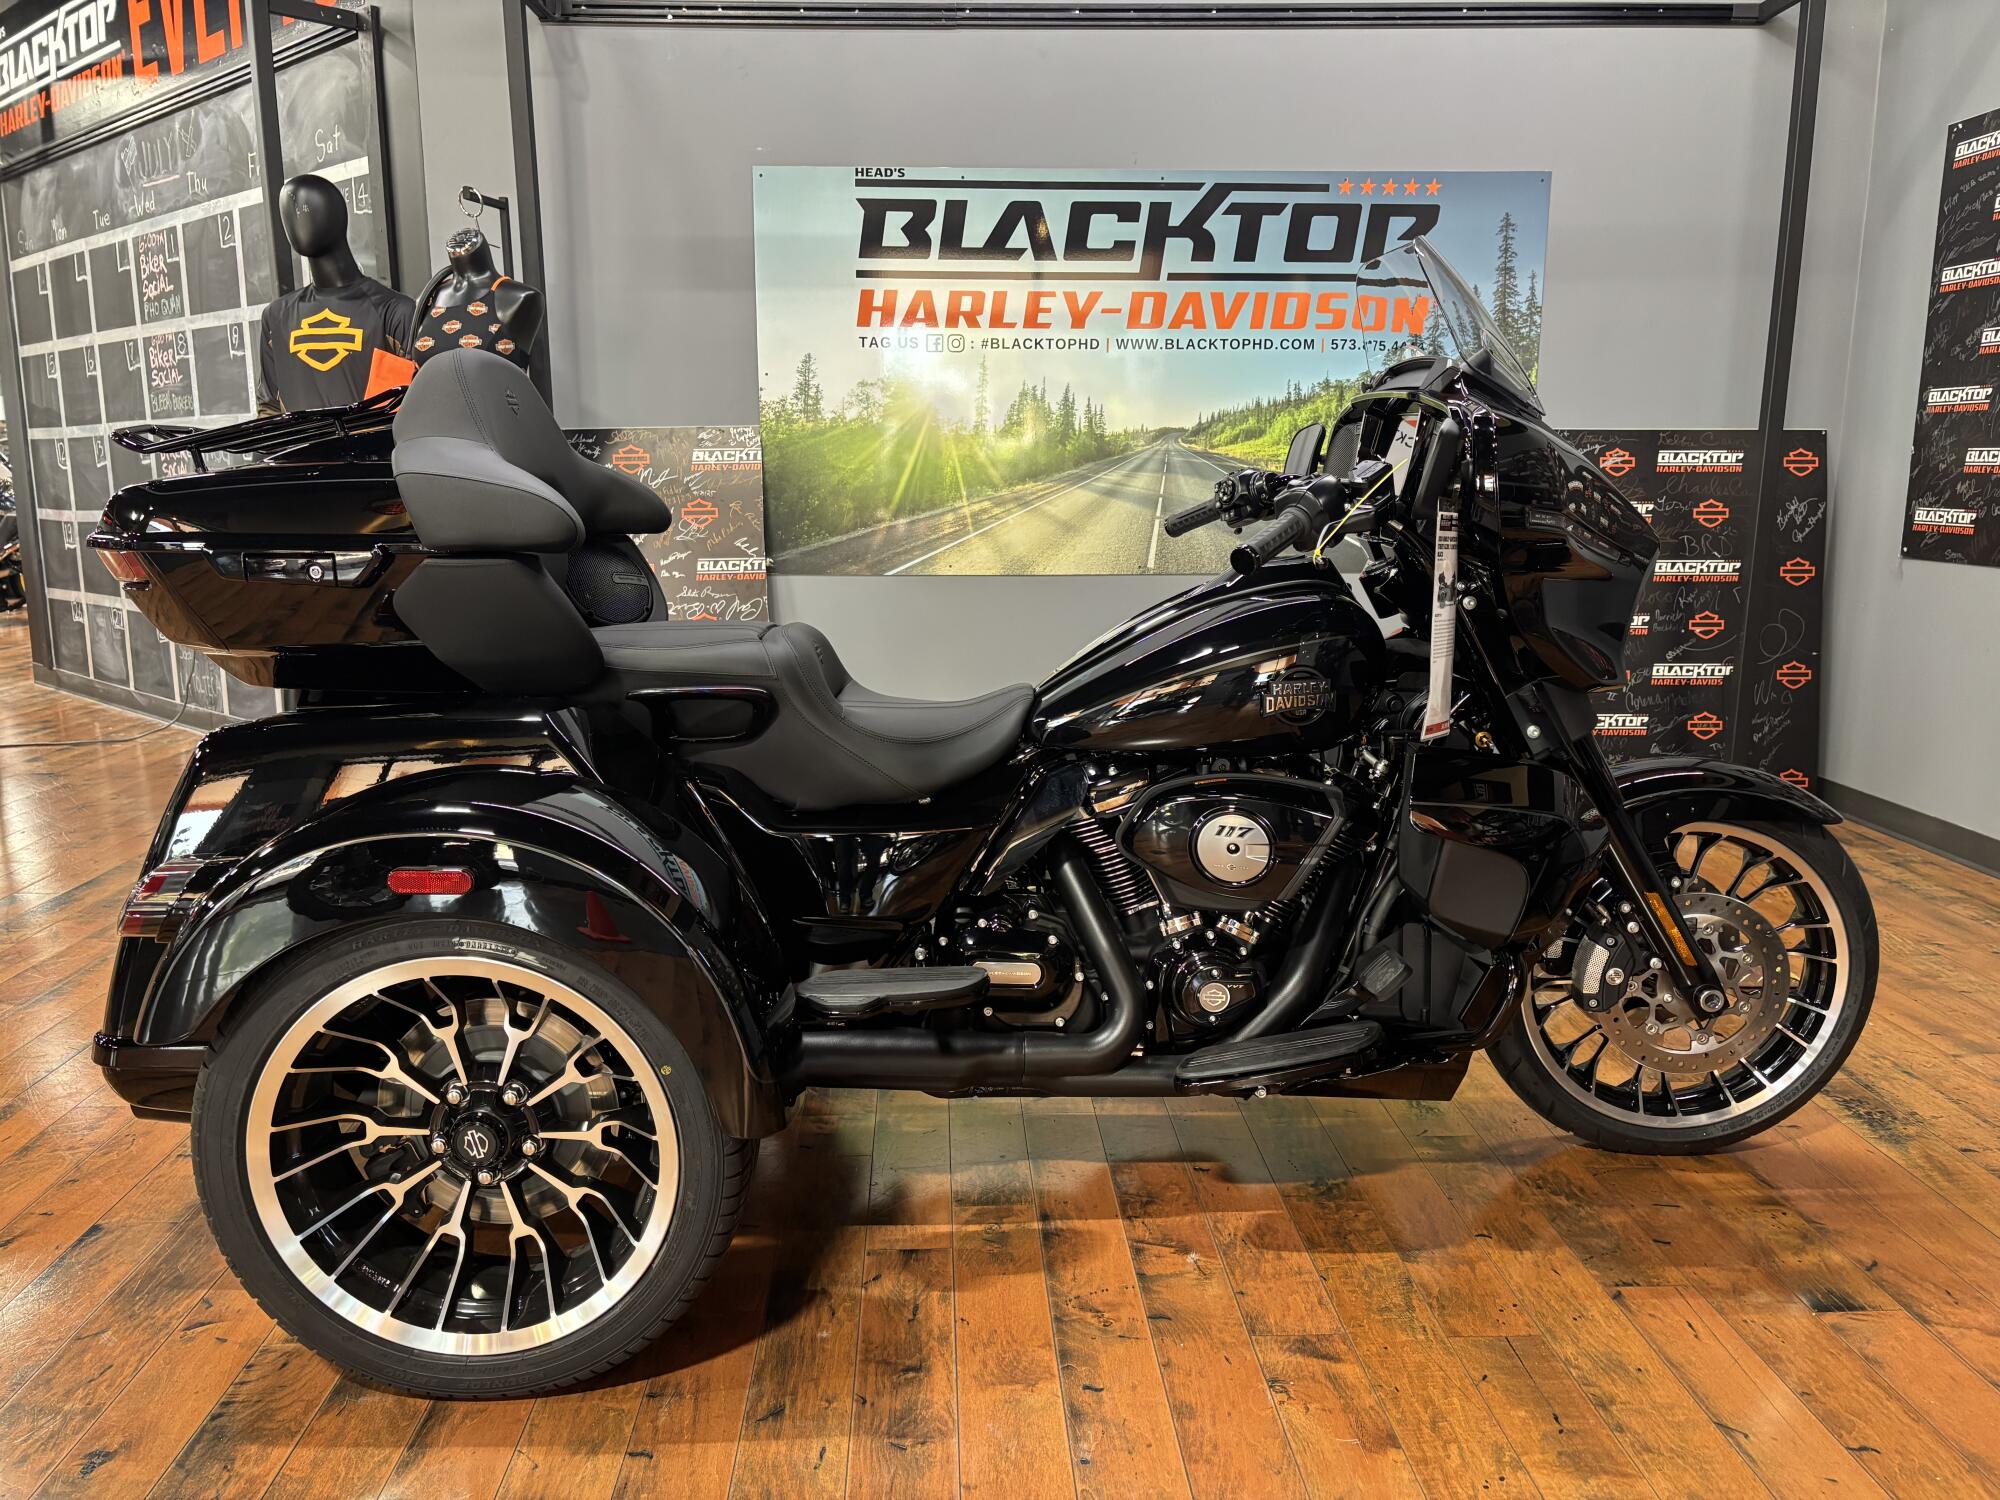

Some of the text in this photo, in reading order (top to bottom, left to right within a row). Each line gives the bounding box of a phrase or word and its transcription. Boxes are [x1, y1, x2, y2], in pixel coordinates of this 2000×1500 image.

[93, 209, 111, 230] Tue
[133, 190, 155, 217] Wed
[186, 171, 209, 196] Thu
[315, 124, 340, 162] Sat
[855, 168, 905, 178] HEAD'S
[358, 182, 368, 207] 4
[223, 215, 232, 240] 2
[855, 188, 1441, 272] BLACKTOP
[856, 289, 1430, 334] HARLEY-DAVIDSON
[177, 333, 186, 354] 8
[858, 336, 1100, 350] TAG US #BLACKTOPHD
[1116, 338, 1315, 350] WWW.BLACKTOPHD.COM
[88, 349, 94, 371] 6
[1927, 387, 1993, 403] BLACKTOP
[1926, 403, 1989, 414] HARLEY-DAVIDSON
[1657, 451, 1744, 465] BLACKTOP
[1656, 465, 1743, 473] HARLEY-DAVIDSON
[1914, 508, 1977, 525] BLACKTOP
[1912, 524, 1974, 535] HARLEY-DAVIDSON
[1654, 560, 1742, 575] BLACKTOP
[1653, 575, 1739, 583] HARLEY-DAVIDSON
[1265, 694, 1337, 714] DAVIDSON
